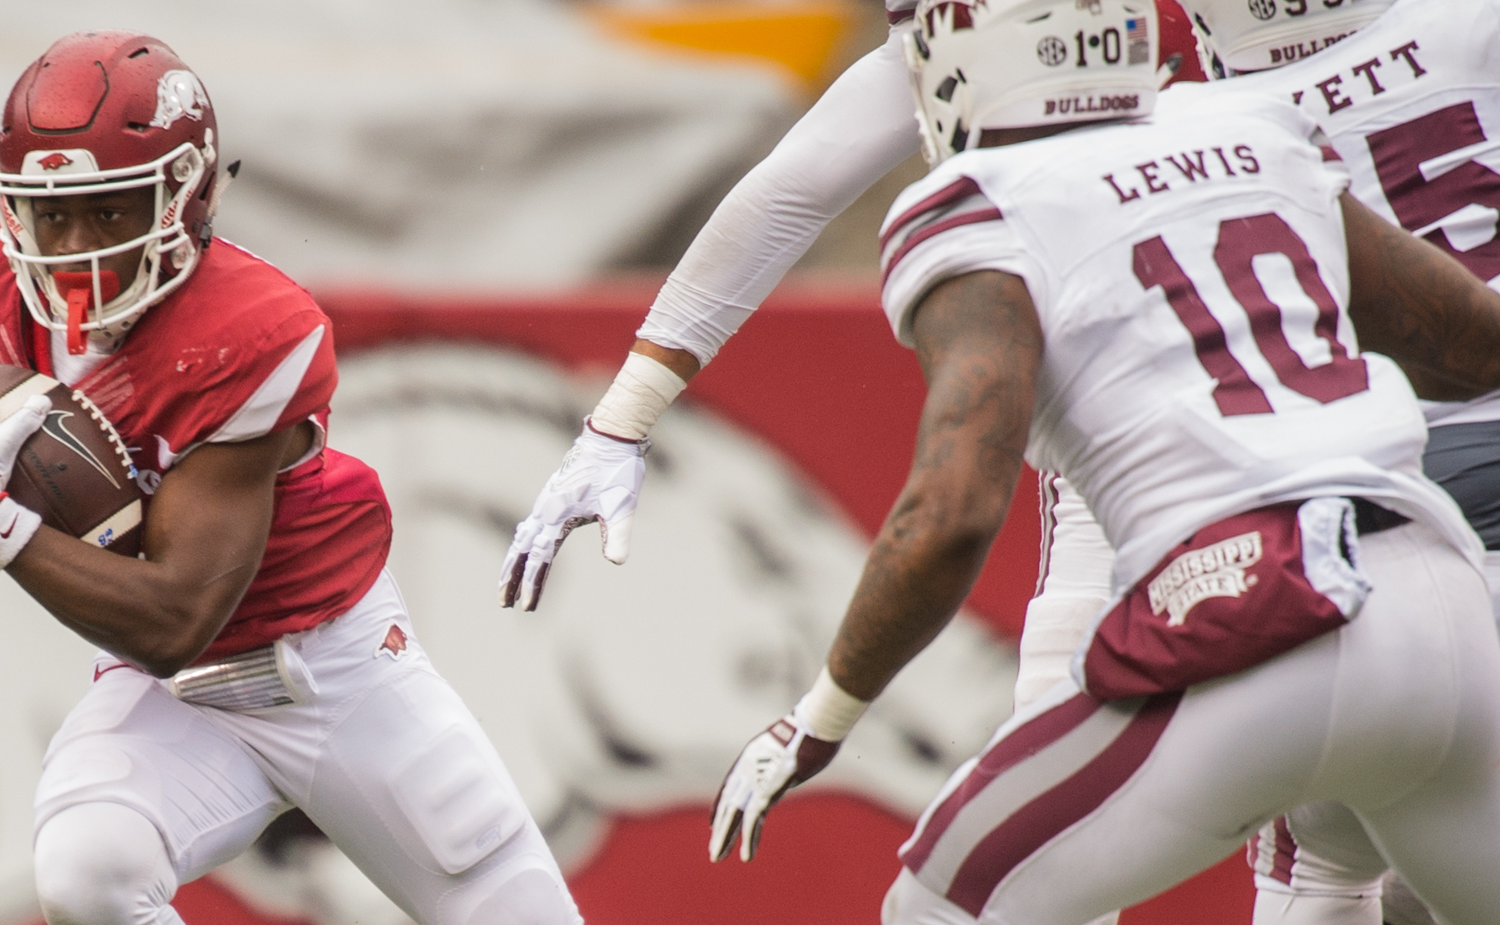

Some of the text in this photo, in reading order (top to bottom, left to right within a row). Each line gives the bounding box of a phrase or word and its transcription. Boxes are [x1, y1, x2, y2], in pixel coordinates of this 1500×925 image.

[1044, 94, 1139, 115] BULLDOGS
[1292, 40, 1427, 115] ETT
[1103, 144, 1262, 204] LEWIS
[1132, 212, 1370, 417] 10
[1148, 534, 1261, 612] MISSISSIPPI
[1171, 573, 1238, 613] STATE
